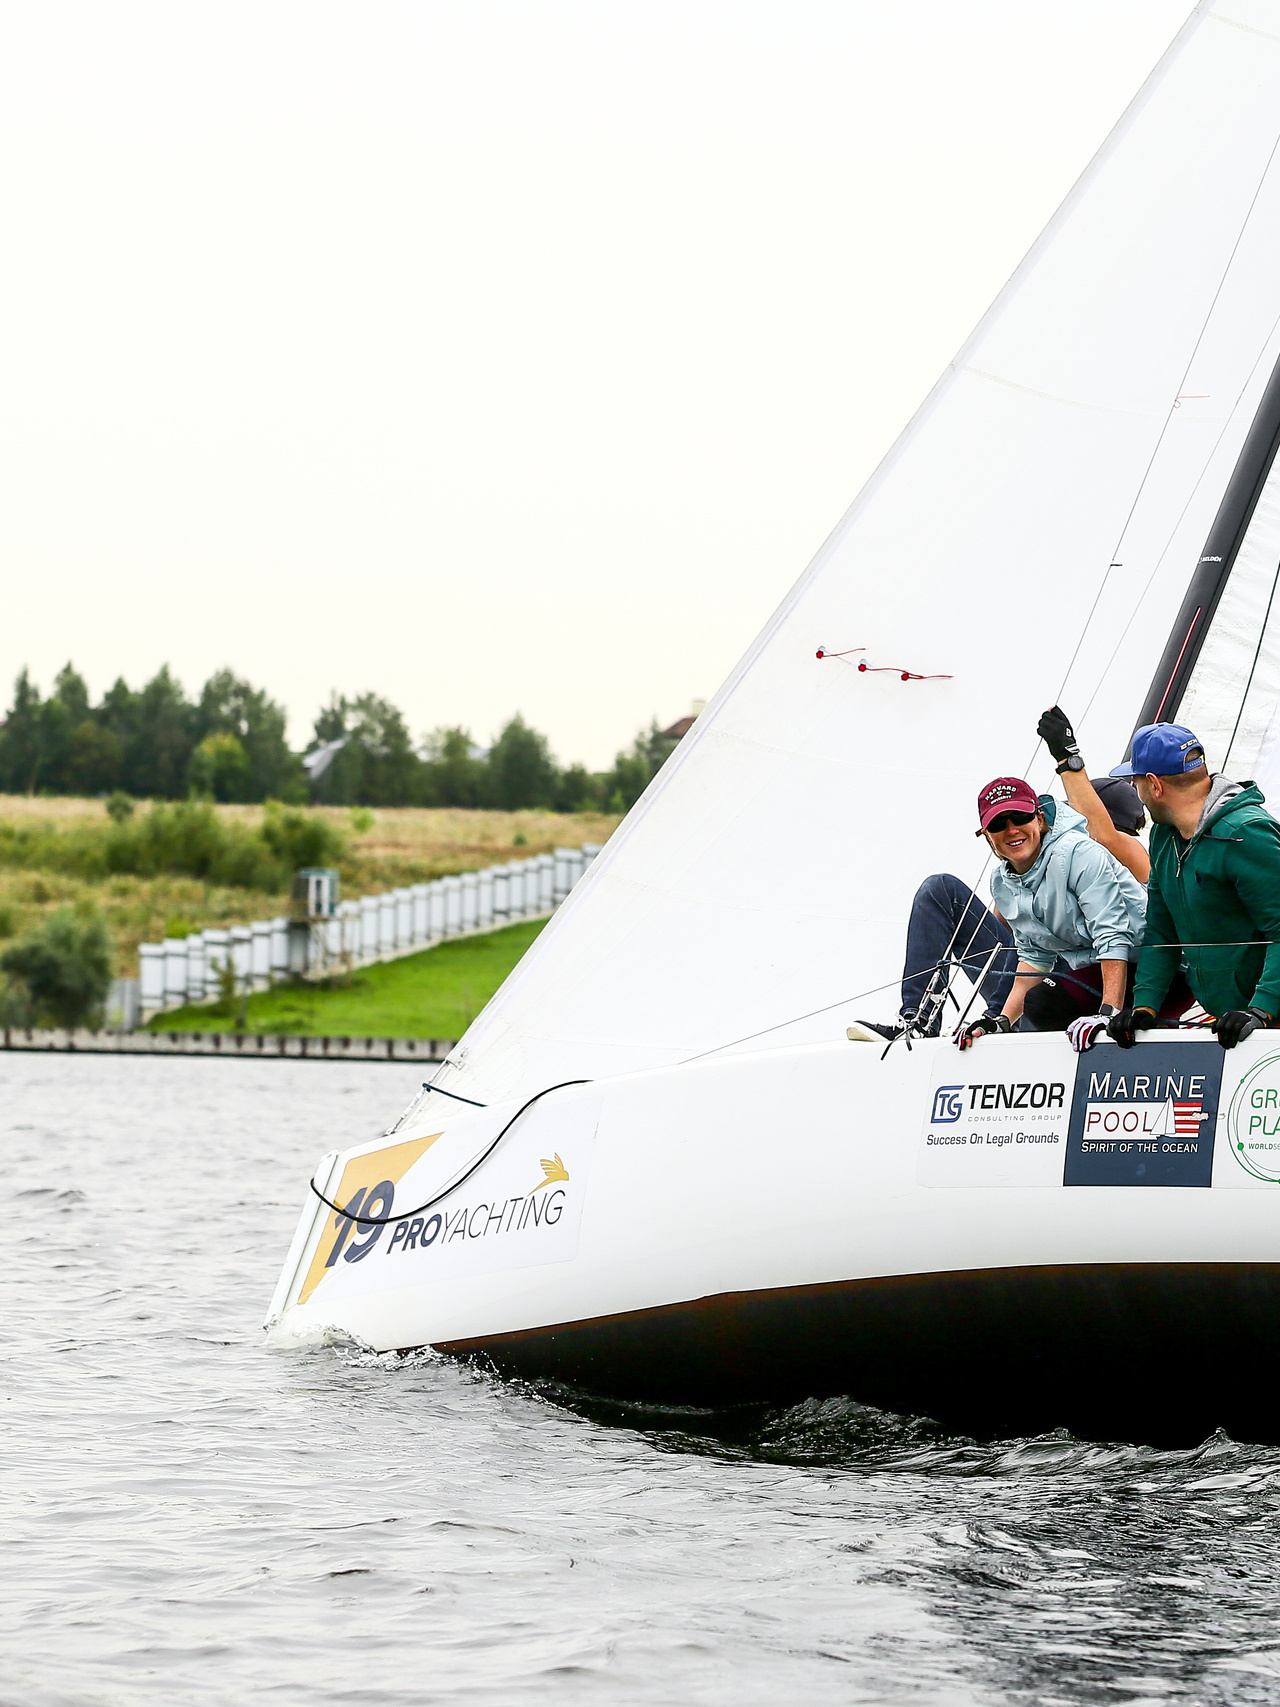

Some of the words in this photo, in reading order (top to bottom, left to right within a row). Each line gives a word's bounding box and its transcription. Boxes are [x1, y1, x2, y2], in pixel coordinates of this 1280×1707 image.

[968, 1083, 1066, 1109] TENZOR
[1087, 1072, 1206, 1099] MARINE
[967, 1115, 1025, 1123] CONSULTING
[1086, 1111, 1153, 1132] POOL
[926, 1134, 967, 1146] Success
[970, 1133, 983, 1144] On
[986, 1132, 1013, 1147] Legal
[1016, 1132, 1060, 1144] Grounds
[1081, 1141, 1117, 1153] SPIRIT
[1120, 1143, 1134, 1153] OF
[1137, 1143, 1159, 1153] THE
[1162, 1143, 1199, 1153] OCEAN
[323, 1179, 395, 1269] 19
[386, 1189, 566, 1255] PROYACHTING
